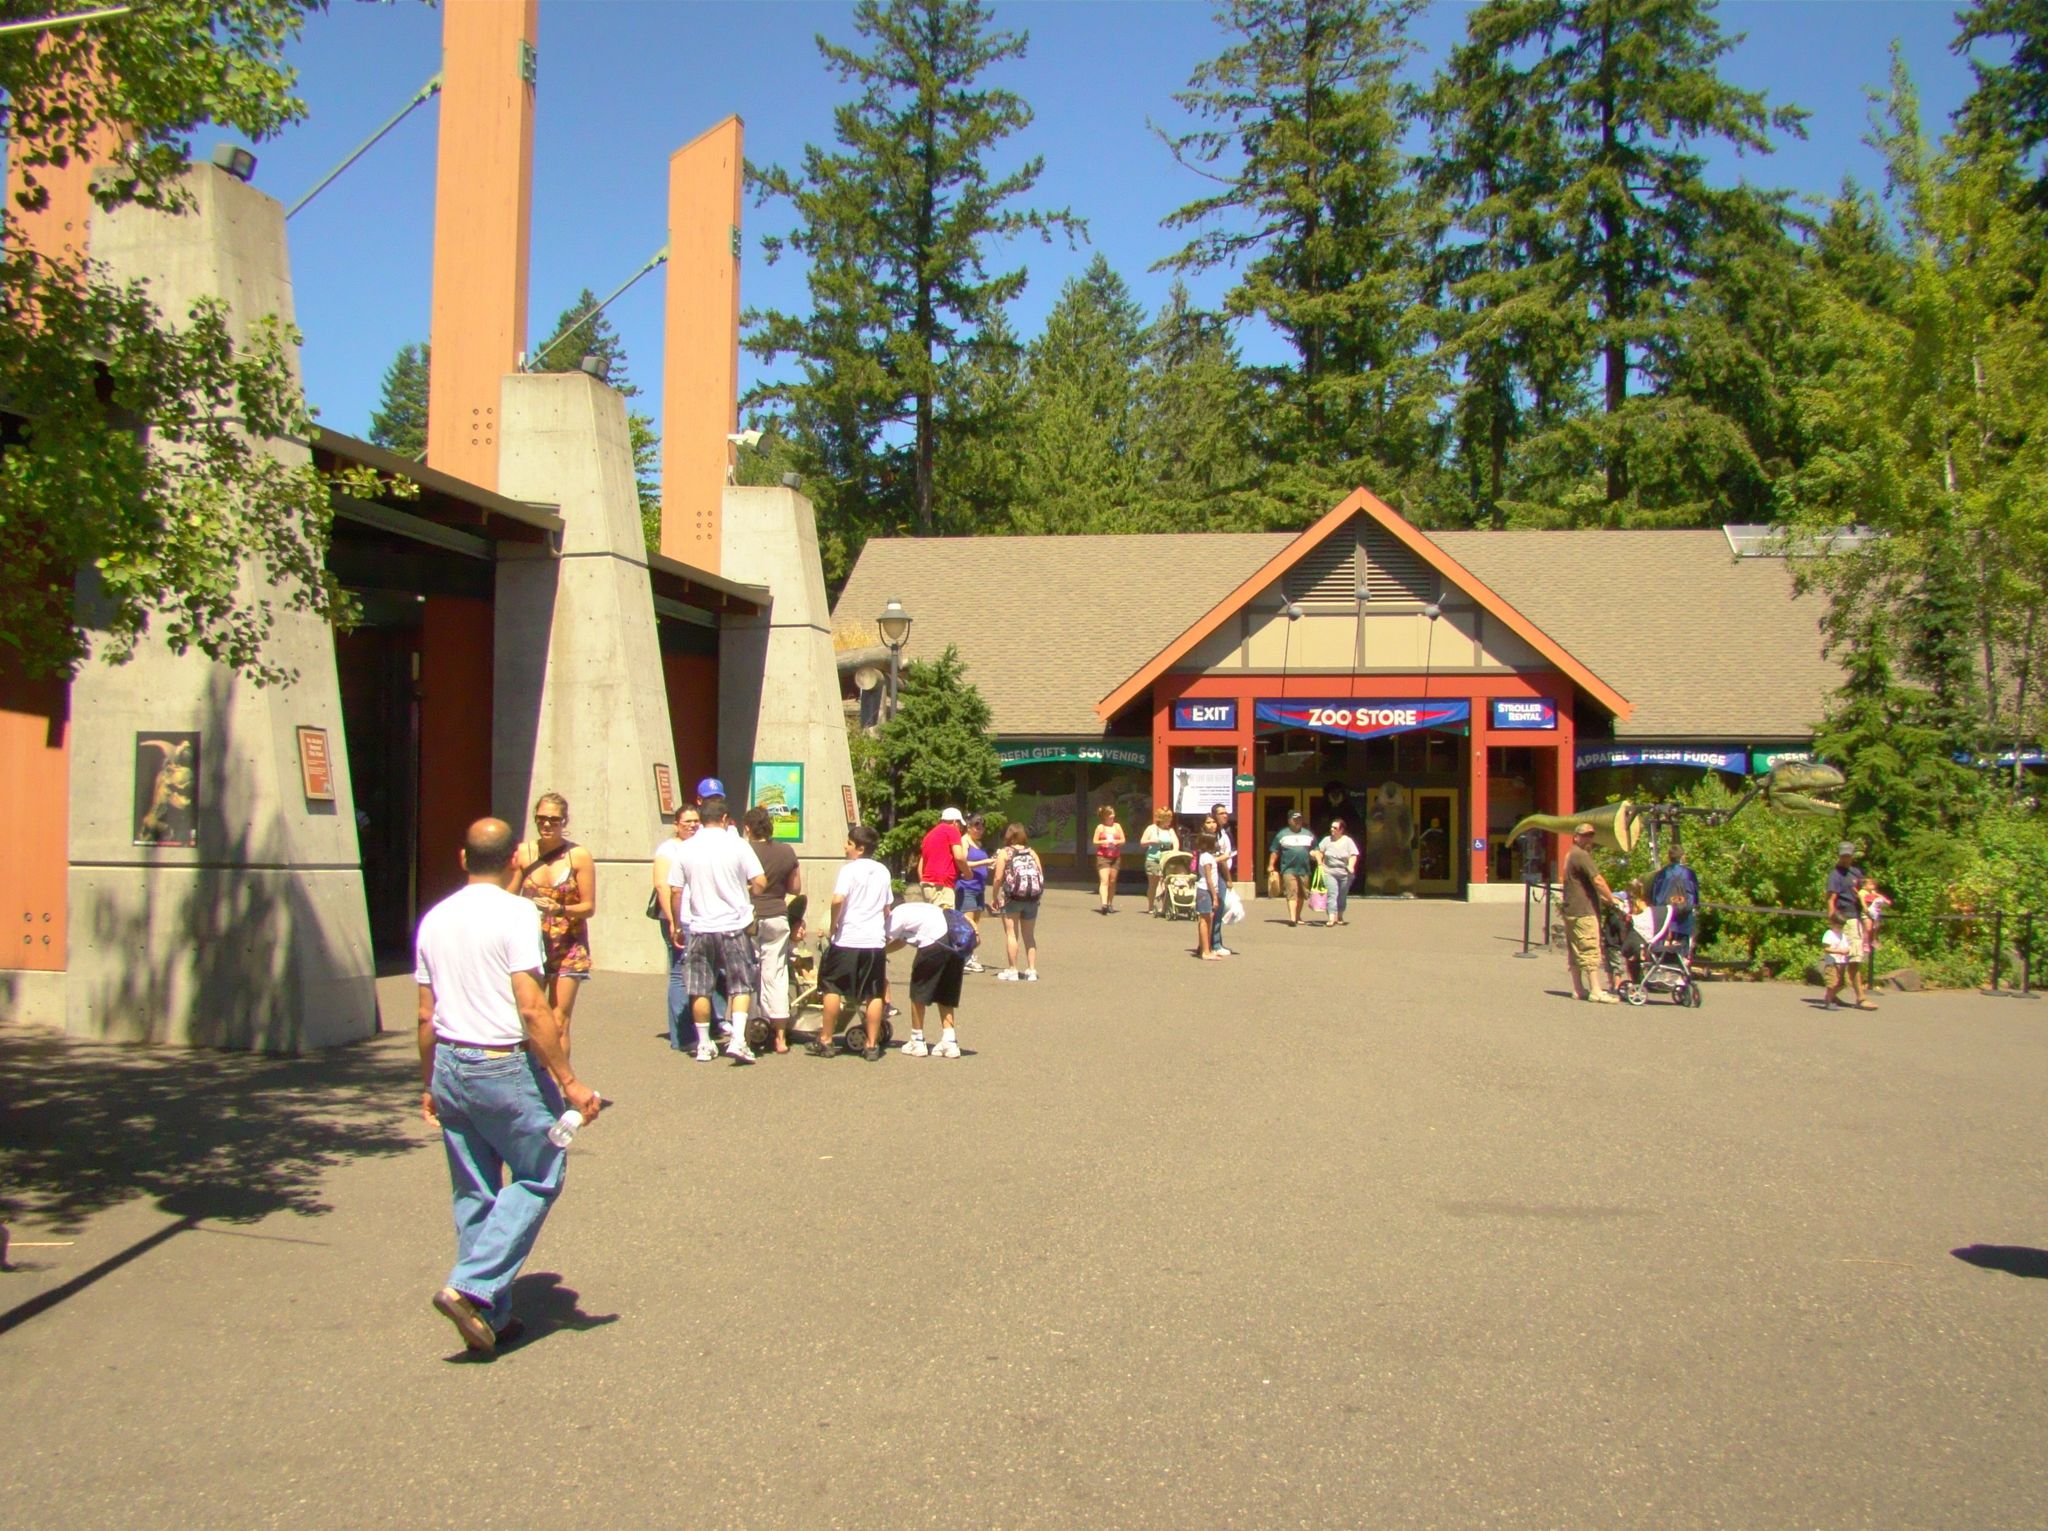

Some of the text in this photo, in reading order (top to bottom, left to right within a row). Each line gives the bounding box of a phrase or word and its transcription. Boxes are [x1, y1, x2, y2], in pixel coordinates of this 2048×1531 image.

[1192, 704, 1229, 721] EXIT
[1497, 703, 1541, 713] STROLLER
[1308, 708, 1417, 726] ZOO STORE
[1508, 713, 1541, 721] RENTAL
[999, 746, 1146, 765] REEN GIFTS SOUVENIRS
[1575, 748, 1727, 768] APPAREL FRESH FUDGE
[1236, 779, 1254, 787] Open
